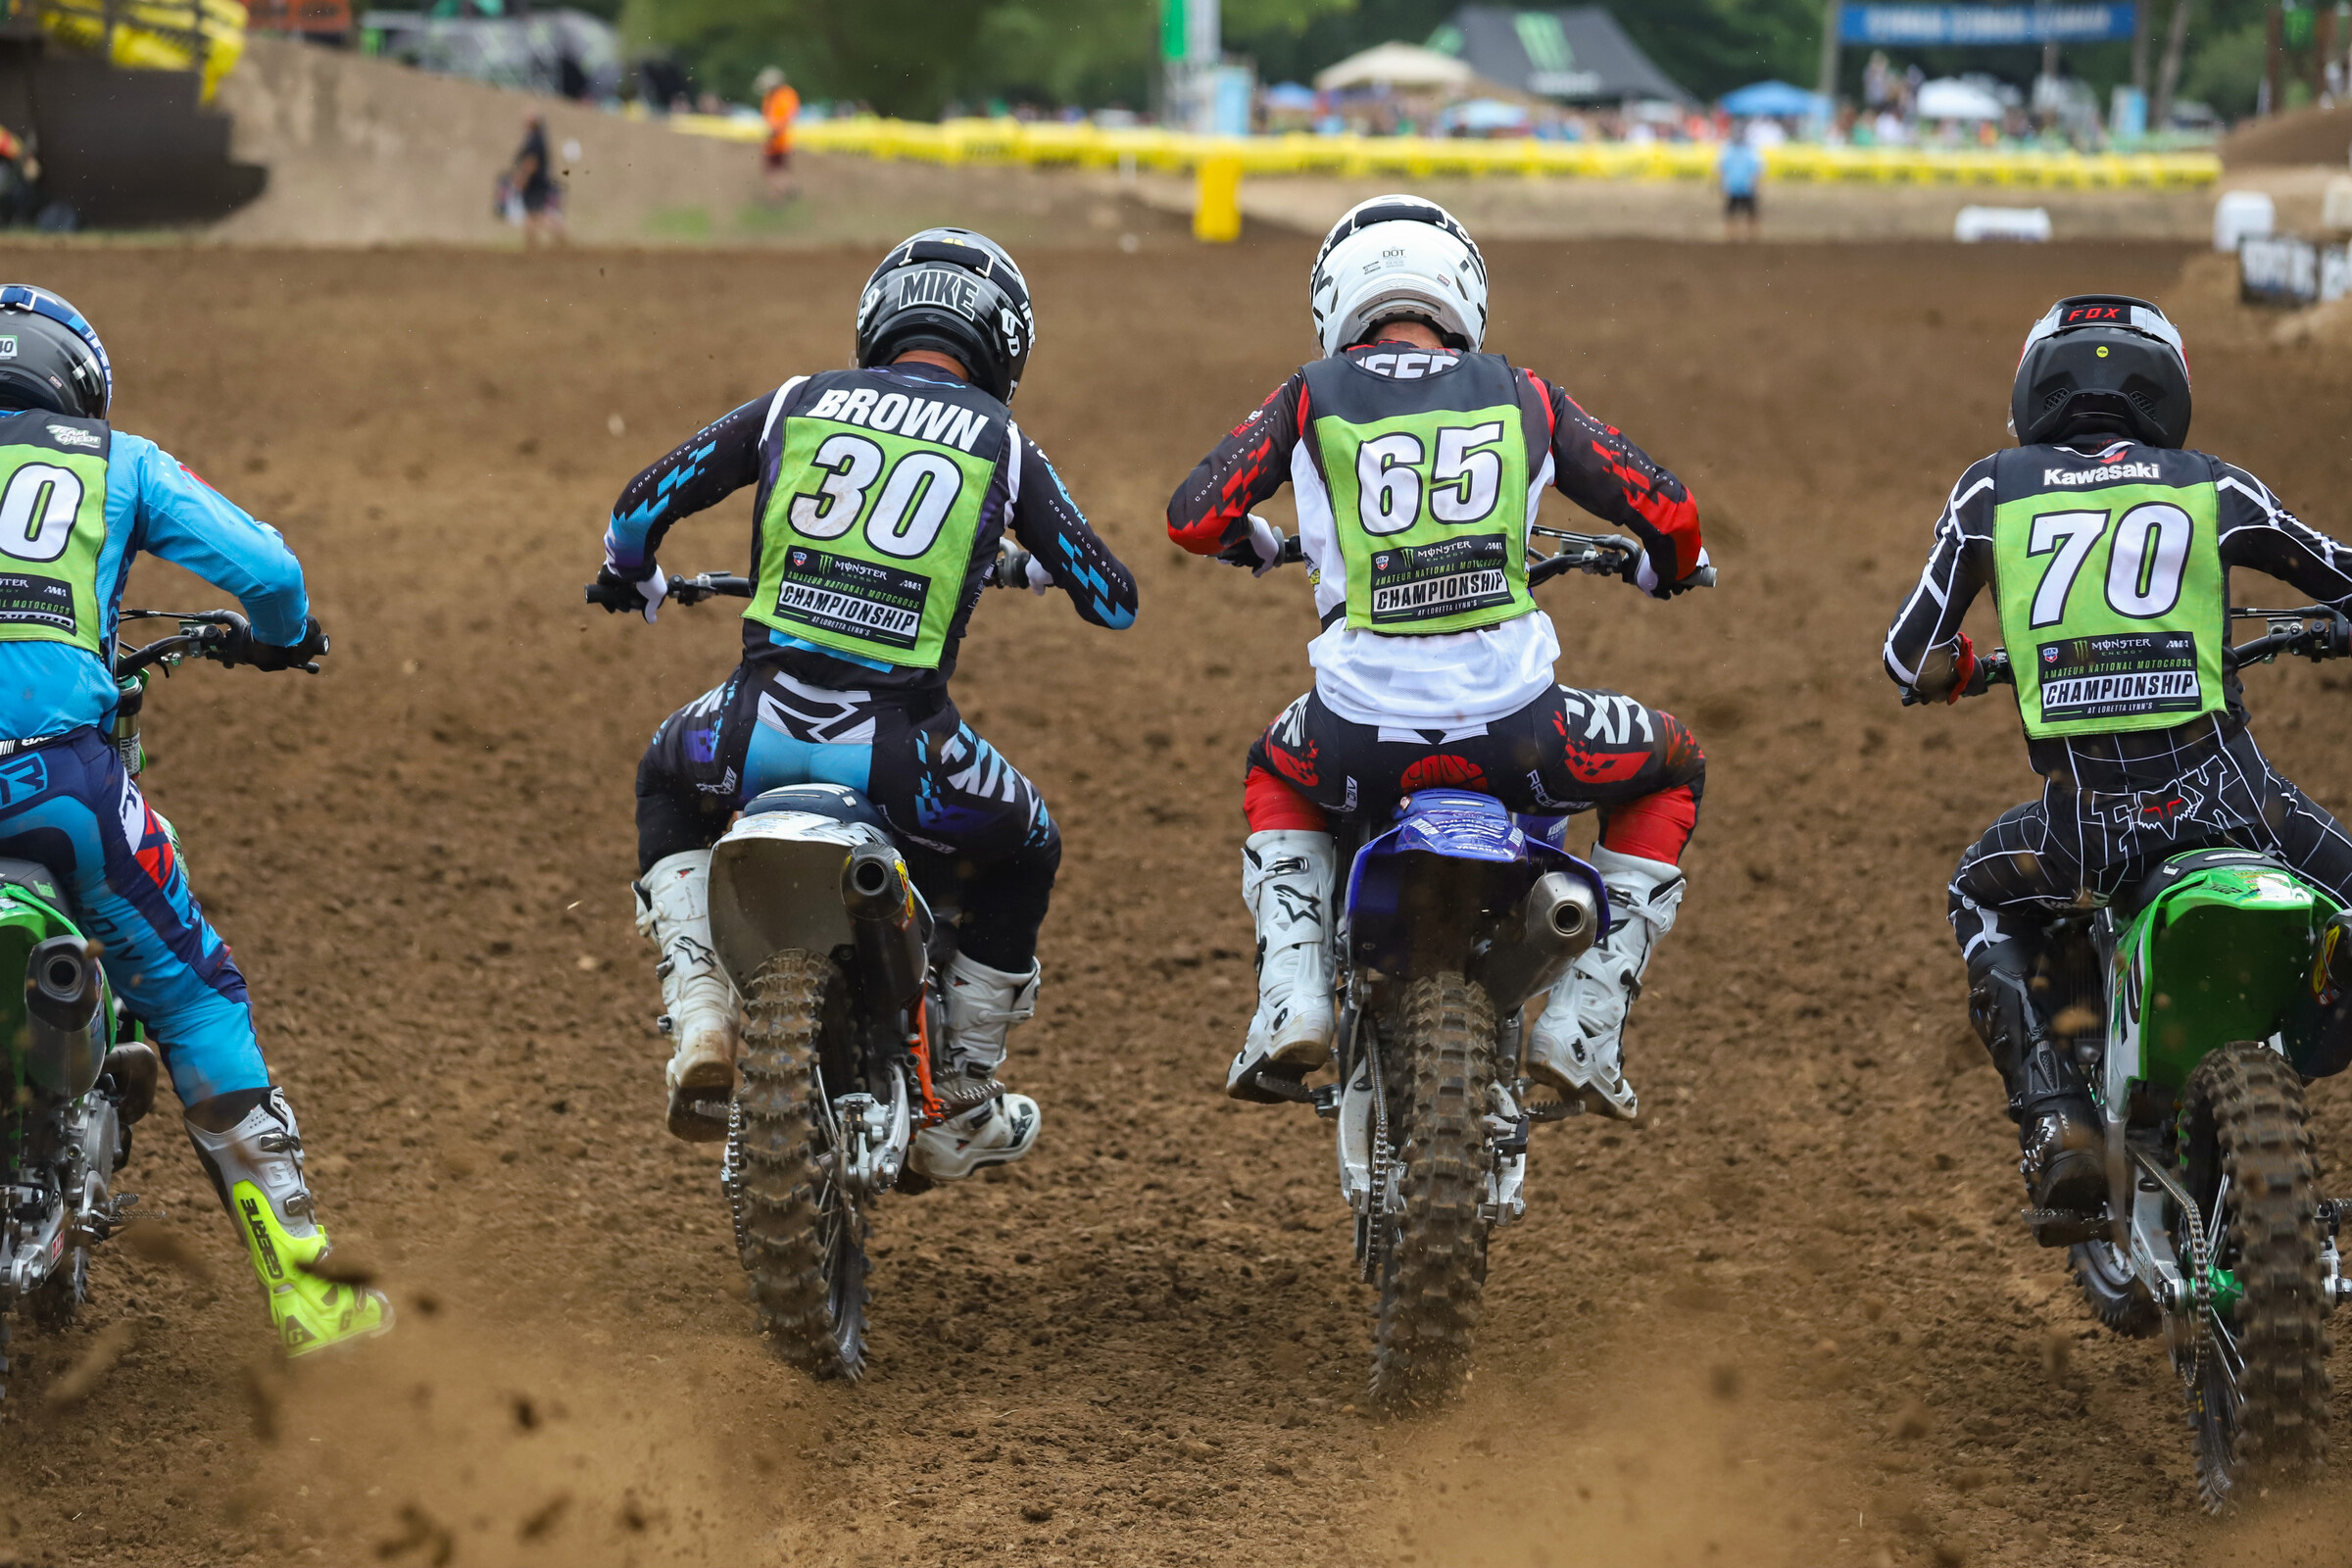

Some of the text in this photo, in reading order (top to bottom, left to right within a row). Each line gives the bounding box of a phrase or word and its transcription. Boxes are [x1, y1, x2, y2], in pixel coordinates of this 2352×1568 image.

[1382, 249, 1405, 258] DOT
[898, 270, 980, 322] MIKE
[2068, 308, 2121, 321] FOX
[805, 388, 990, 453] BROWN
[1355, 420, 1504, 537] 65
[2043, 462, 2161, 486] Kawasaki
[788, 432, 963, 560] 30
[1375, 571, 1411, 586] AMATEUR
[1415, 564, 1455, 578] NATIONAL
[2026, 501, 2194, 631] 70
[43, 585, 68, 597] AMA
[788, 570, 920, 610] AMATEUR NATIONAL MOTOCROSS
[1376, 571, 1502, 611] CHAMPIONSHIP
[12, 600, 71, 615] MOTOCROSS
[781, 585, 916, 632] CHAMPIONSHIP
[1427, 603, 1453, 615] LORETTA
[1454, 599, 1478, 612] LYNN'S
[820, 617, 848, 632] LORETTA
[847, 623, 871, 637] LYNN'S
[2166, 640, 2189, 649] AMA
[2044, 659, 2193, 680] AMATEUR NATIONAL MOTOCROSS
[2045, 673, 2194, 706] CHAMPIONSHIP
[2097, 704, 2127, 713] LORETTA
[2129, 702, 2153, 711] LYNN'S
[1527, 769, 1556, 808] RACE
